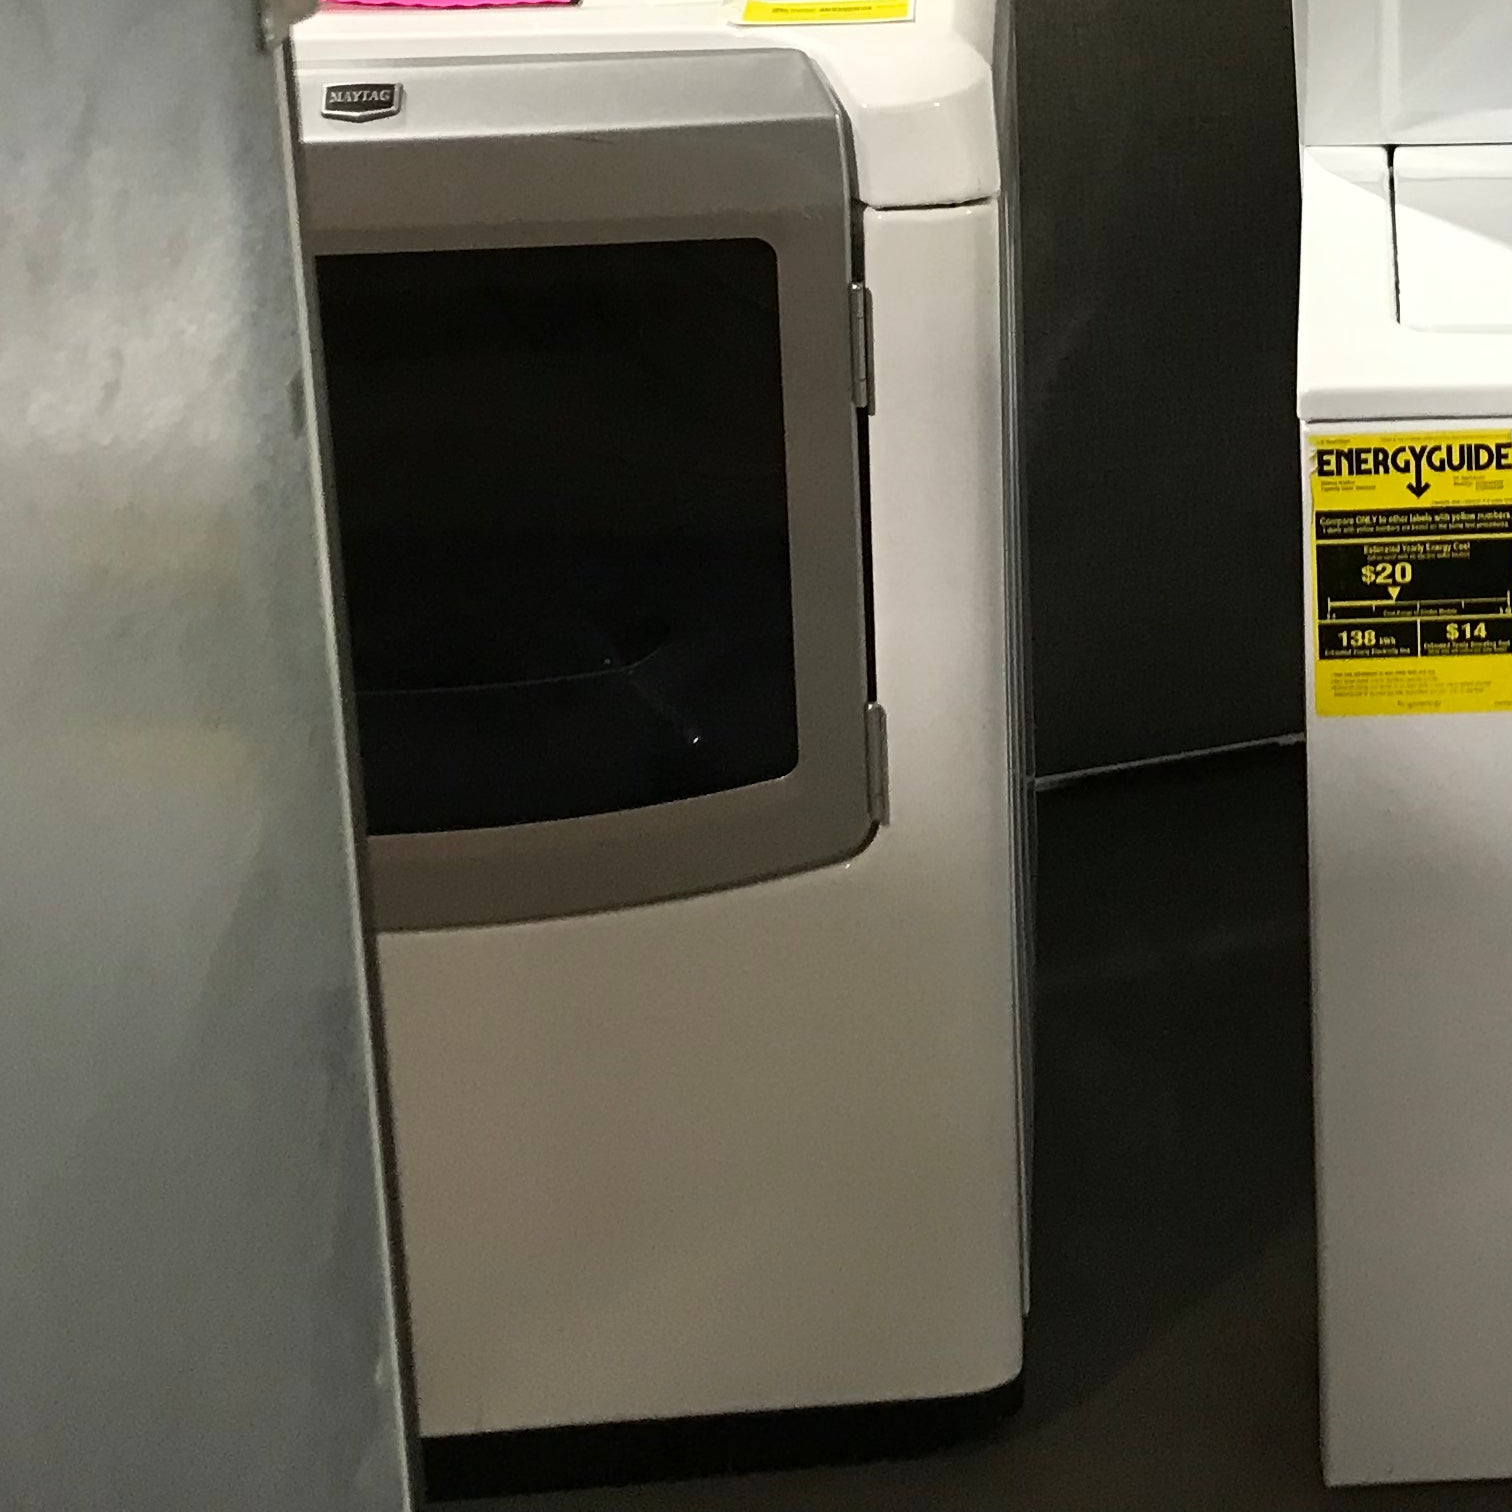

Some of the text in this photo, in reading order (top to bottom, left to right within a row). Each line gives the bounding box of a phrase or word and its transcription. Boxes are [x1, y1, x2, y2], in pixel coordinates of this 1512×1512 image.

[329, 89, 391, 104] MAYTAG
[1320, 516, 1354, 528] Compare
[1356, 514, 1378, 524] ONLY
[1389, 513, 1408, 524] other
[1410, 512, 1433, 523] labels
[1435, 511, 1450, 522] with
[1452, 511, 1475, 523] yellow
[1402, 543, 1425, 555] Yearly
[1426, 542, 1450, 554] Energy
[1362, 562, 1412, 584] $20
[1338, 630, 1376, 647] 138
[1446, 622, 1487, 640] $14
